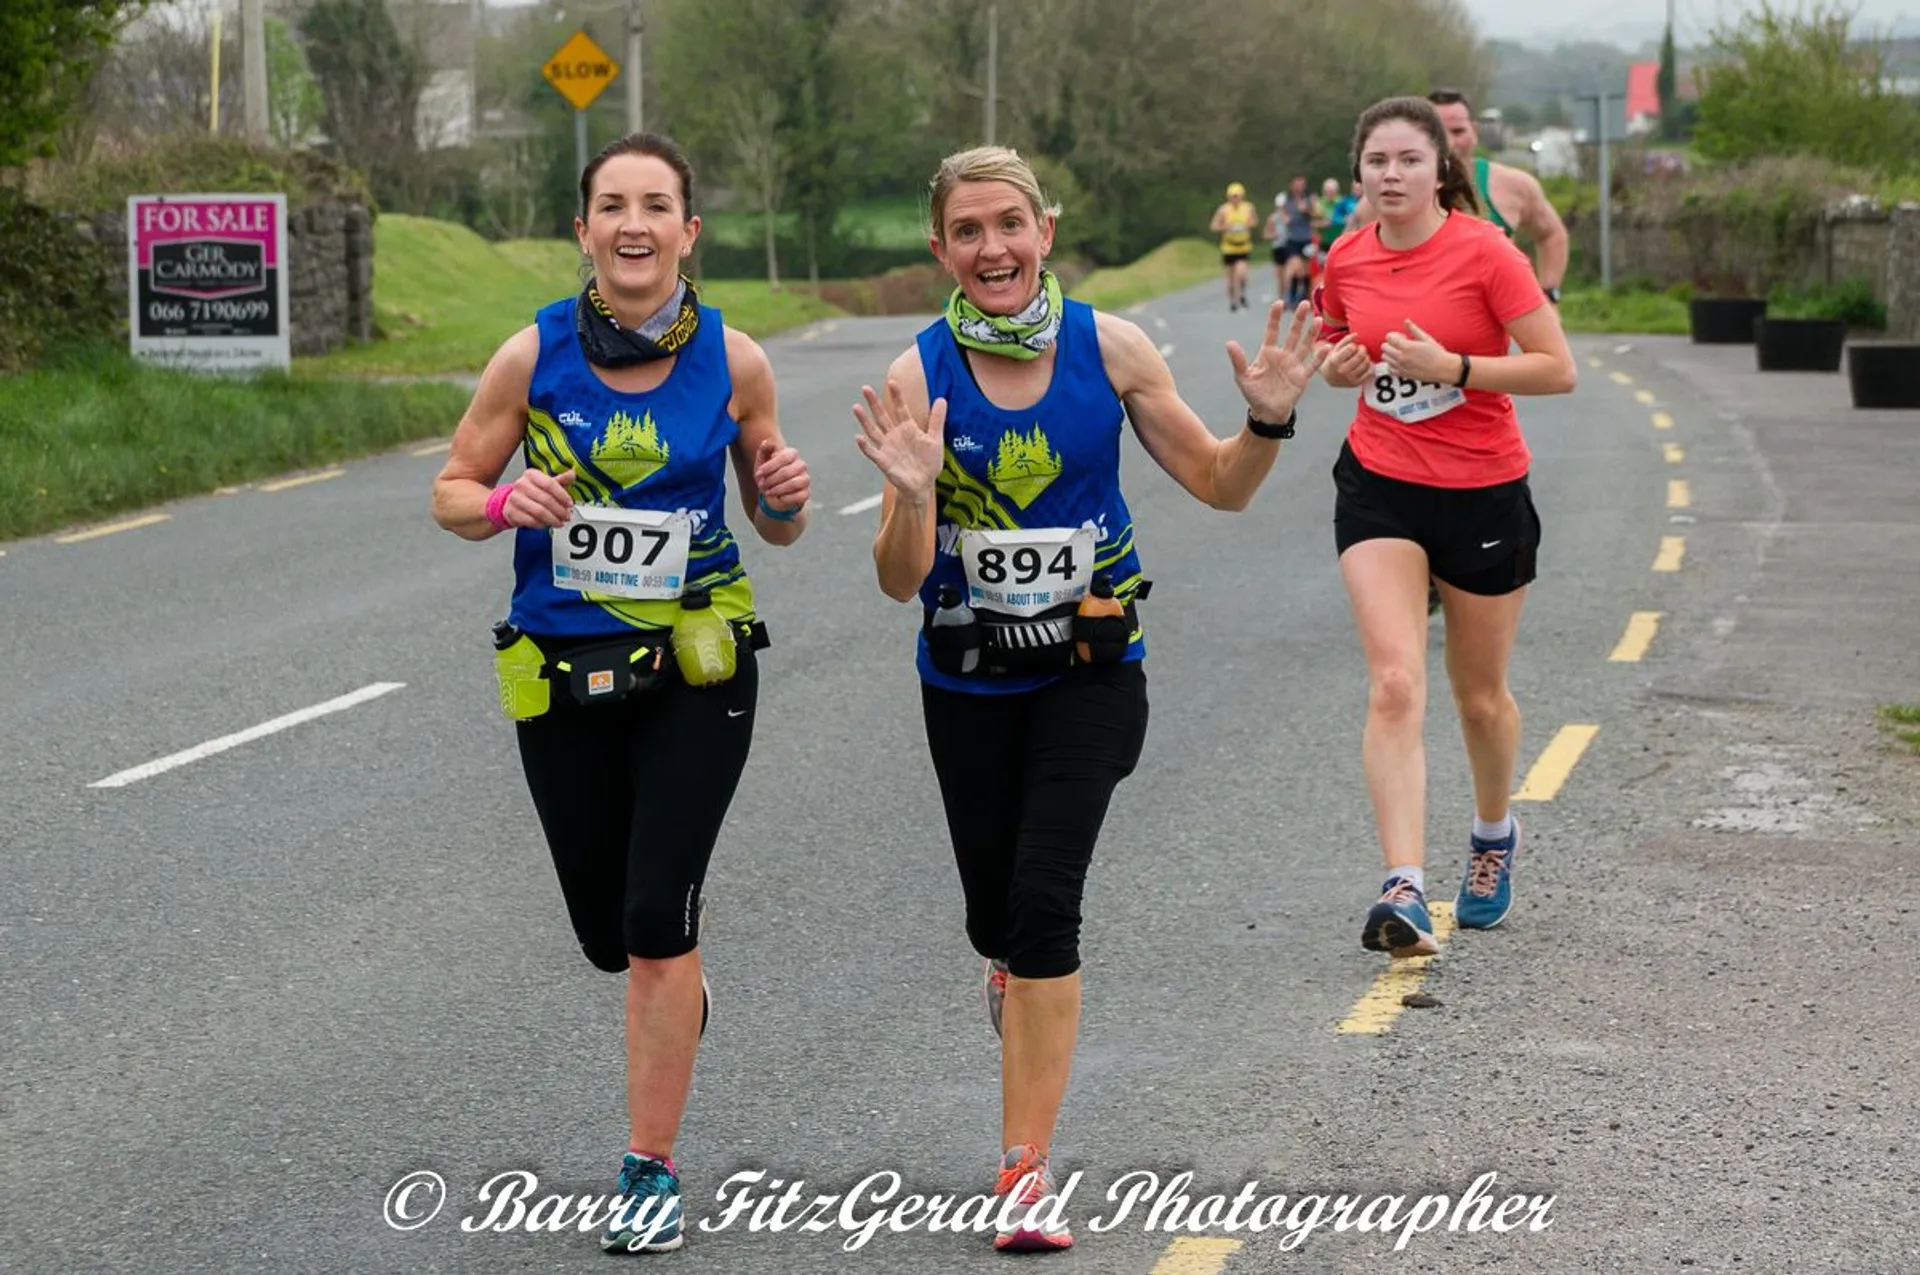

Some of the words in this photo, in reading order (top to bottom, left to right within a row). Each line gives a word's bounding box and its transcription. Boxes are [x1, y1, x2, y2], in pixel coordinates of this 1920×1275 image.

[551, 61, 610, 80] SLOW
[144, 204, 200, 232] FOR
[205, 204, 269, 232] SALE
[185, 245, 228, 266] GER
[156, 260, 259, 279] CARMODY
[149, 301, 185, 320] 066
[190, 300, 270, 321] 7190699
[568, 523, 671, 567] 907
[977, 545, 1077, 585] 894
[594, 570, 619, 586] ABOUT
[620, 572, 639, 587] TIME
[1006, 592, 1031, 606] ABOUT
[1031, 591, 1051, 605] TIME
